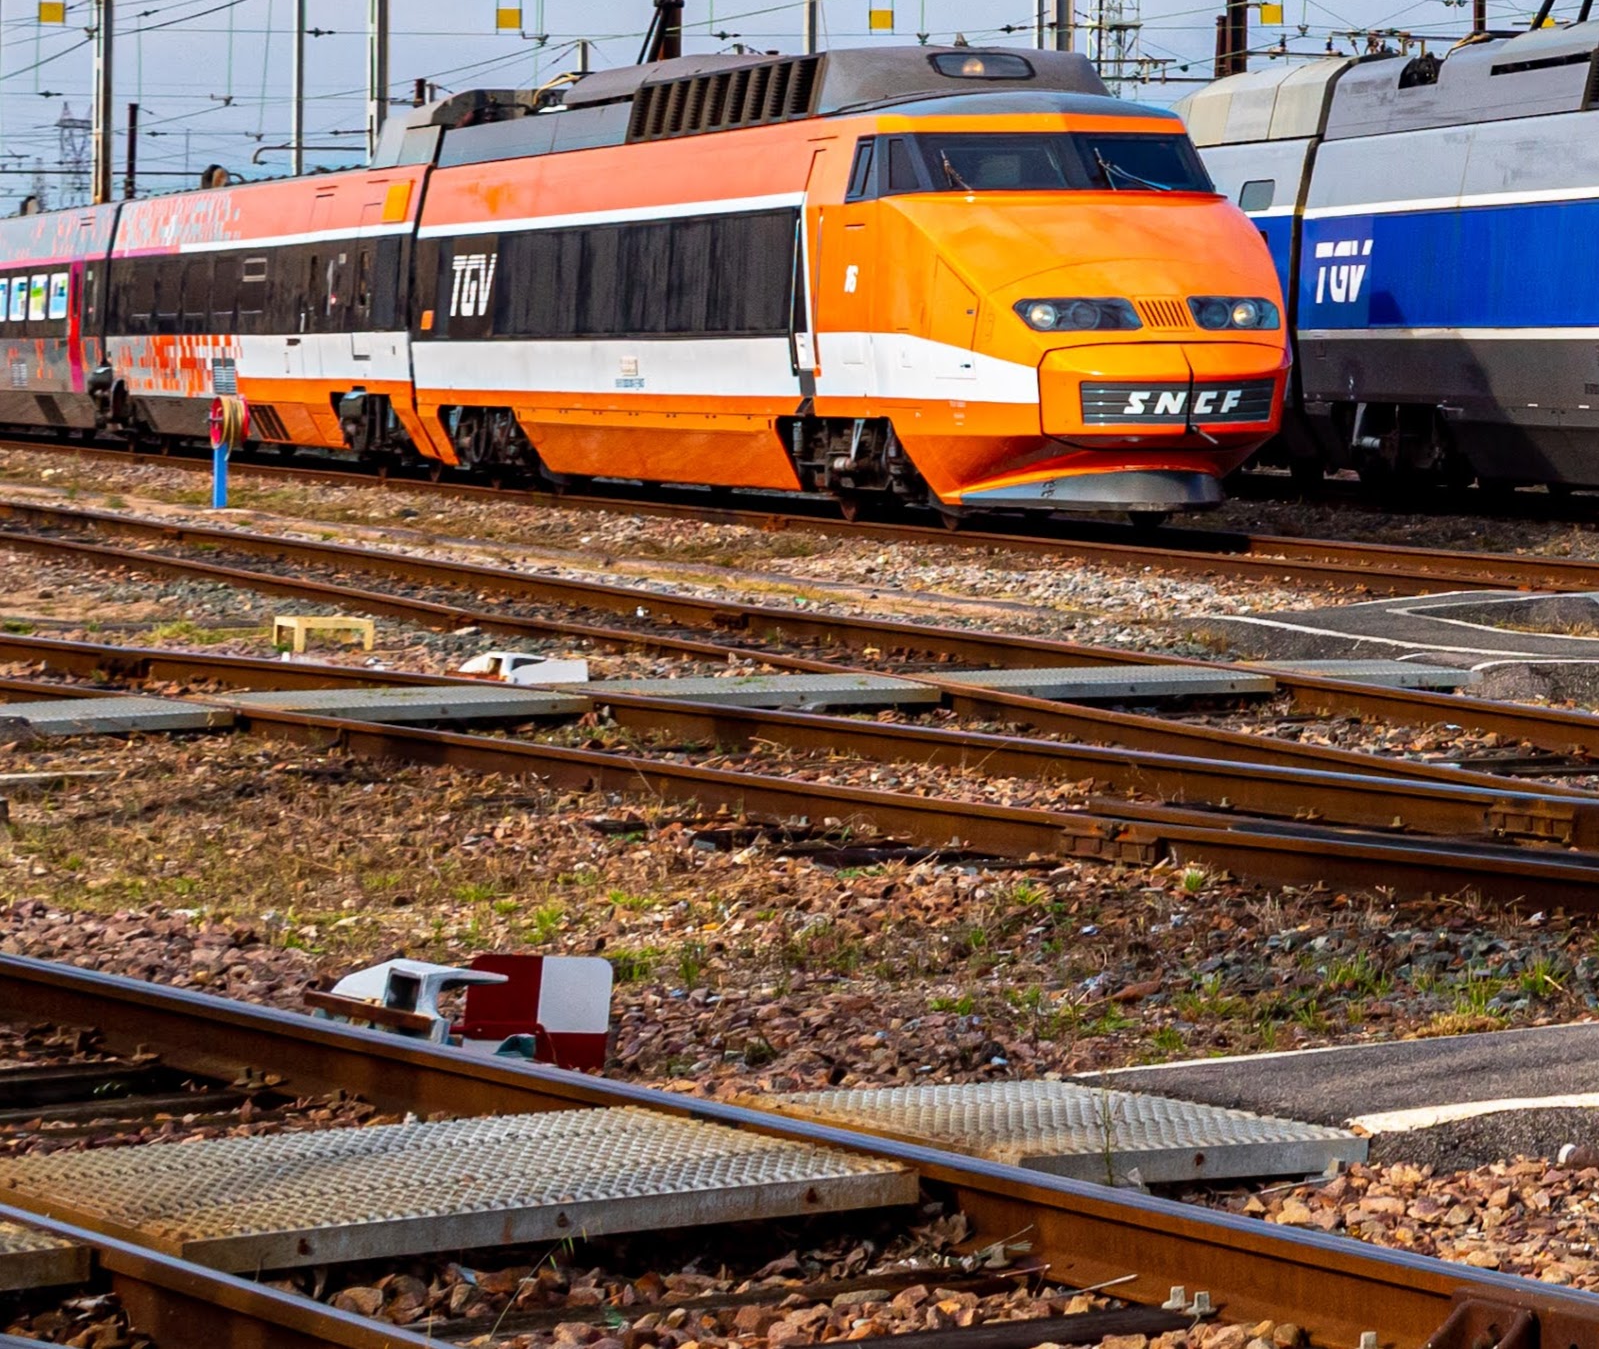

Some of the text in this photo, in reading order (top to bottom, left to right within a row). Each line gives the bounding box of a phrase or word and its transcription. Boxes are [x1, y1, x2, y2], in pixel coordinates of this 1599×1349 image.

[449, 253, 498, 317] TGV
[1315, 239, 1374, 304] TGV
[1123, 389, 1242, 415] SNCF
